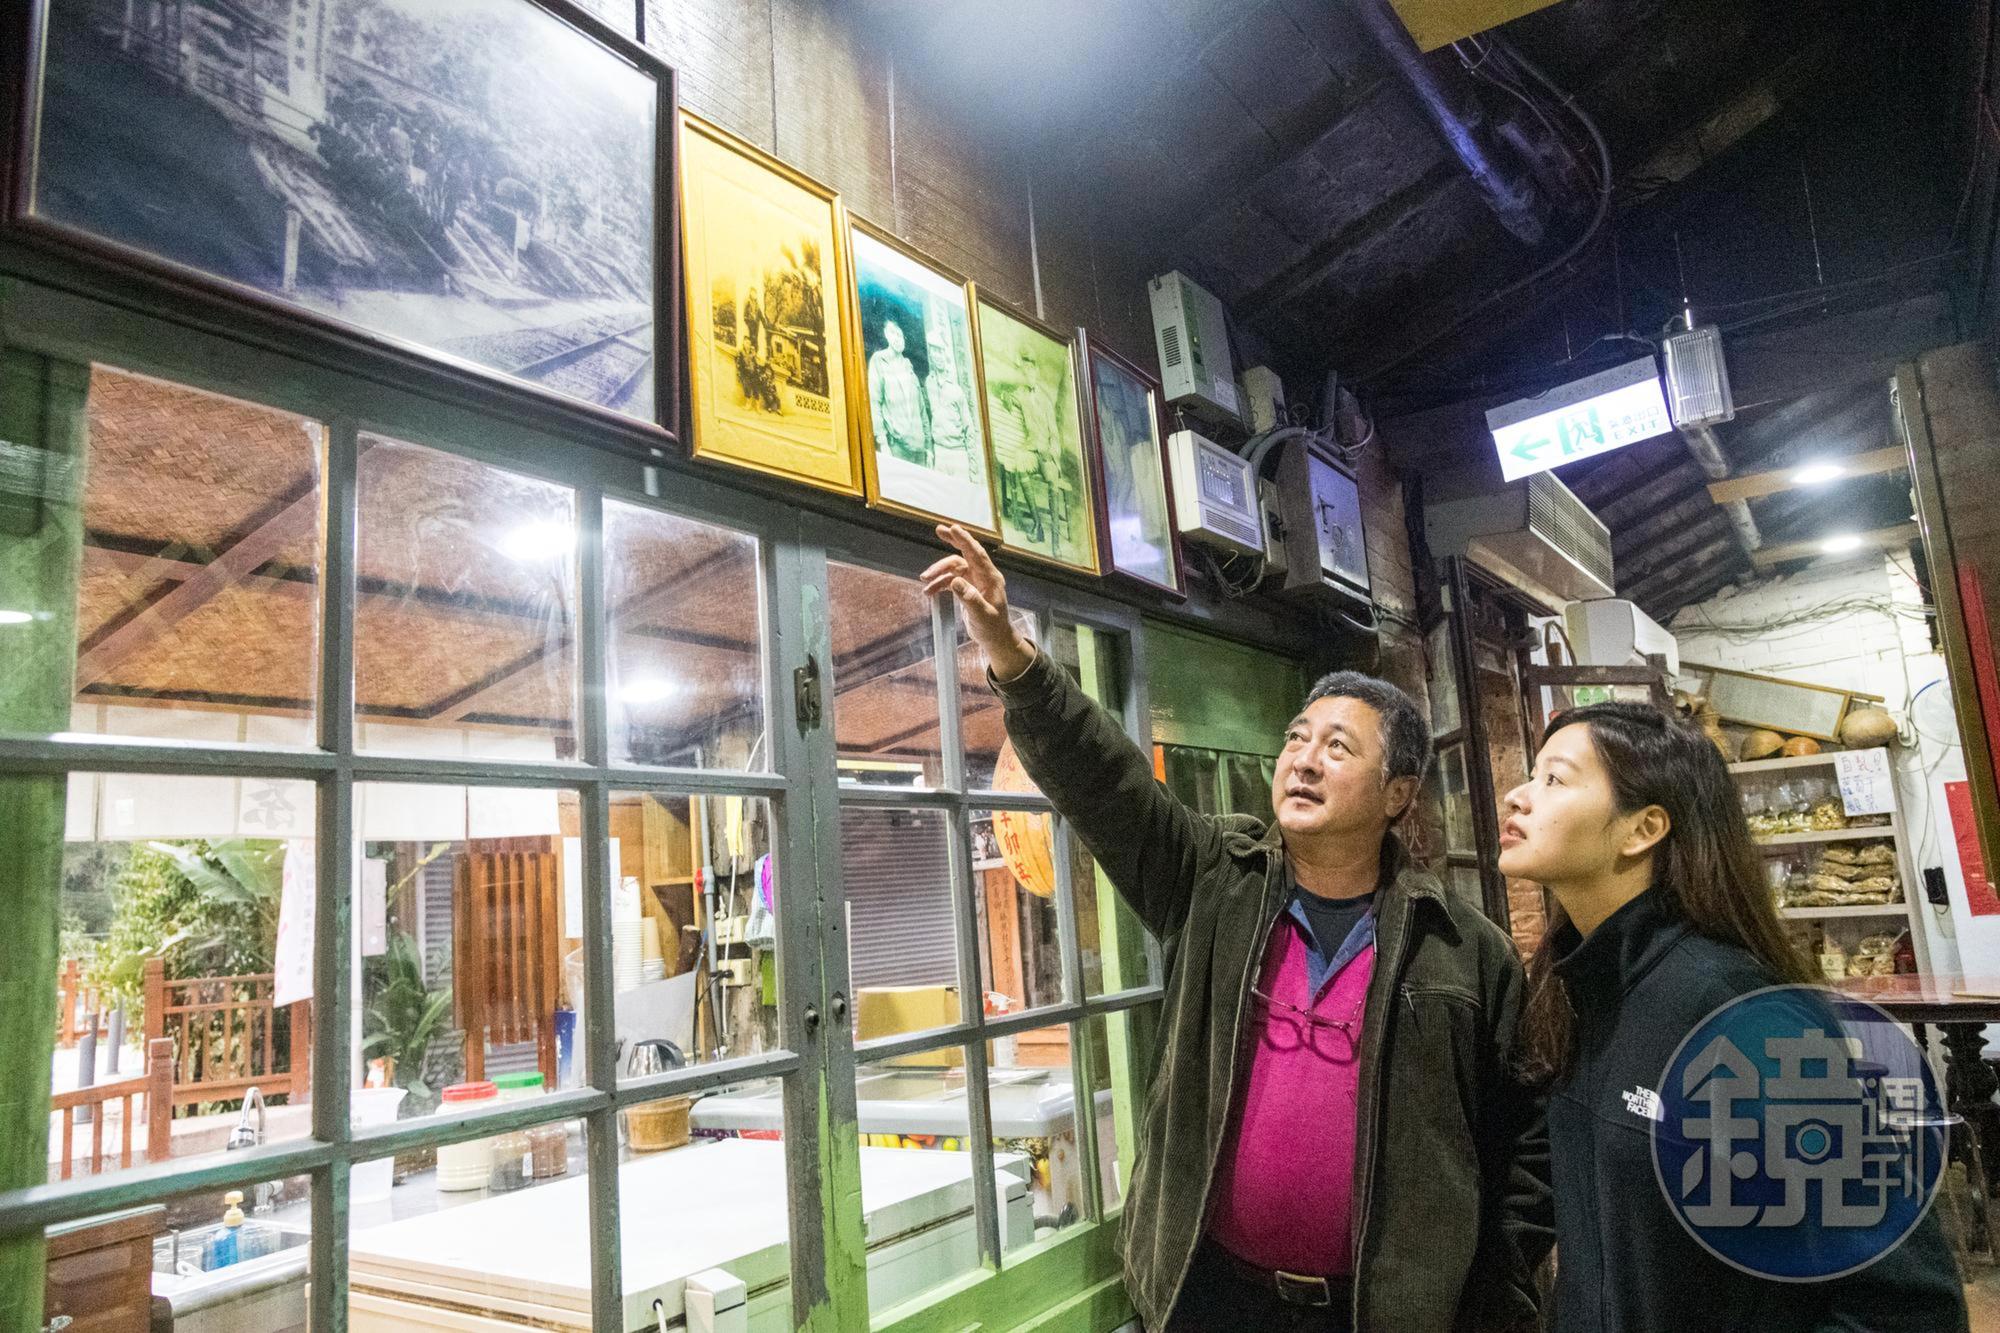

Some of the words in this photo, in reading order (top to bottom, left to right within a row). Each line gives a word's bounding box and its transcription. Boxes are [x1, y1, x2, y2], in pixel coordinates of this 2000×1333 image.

[1614, 418, 1657, 440] EXIT
[1621, 1090, 1650, 1108] NORTH
[1635, 1085, 1651, 1098] THE
[1626, 1101, 1650, 1118] FACE
